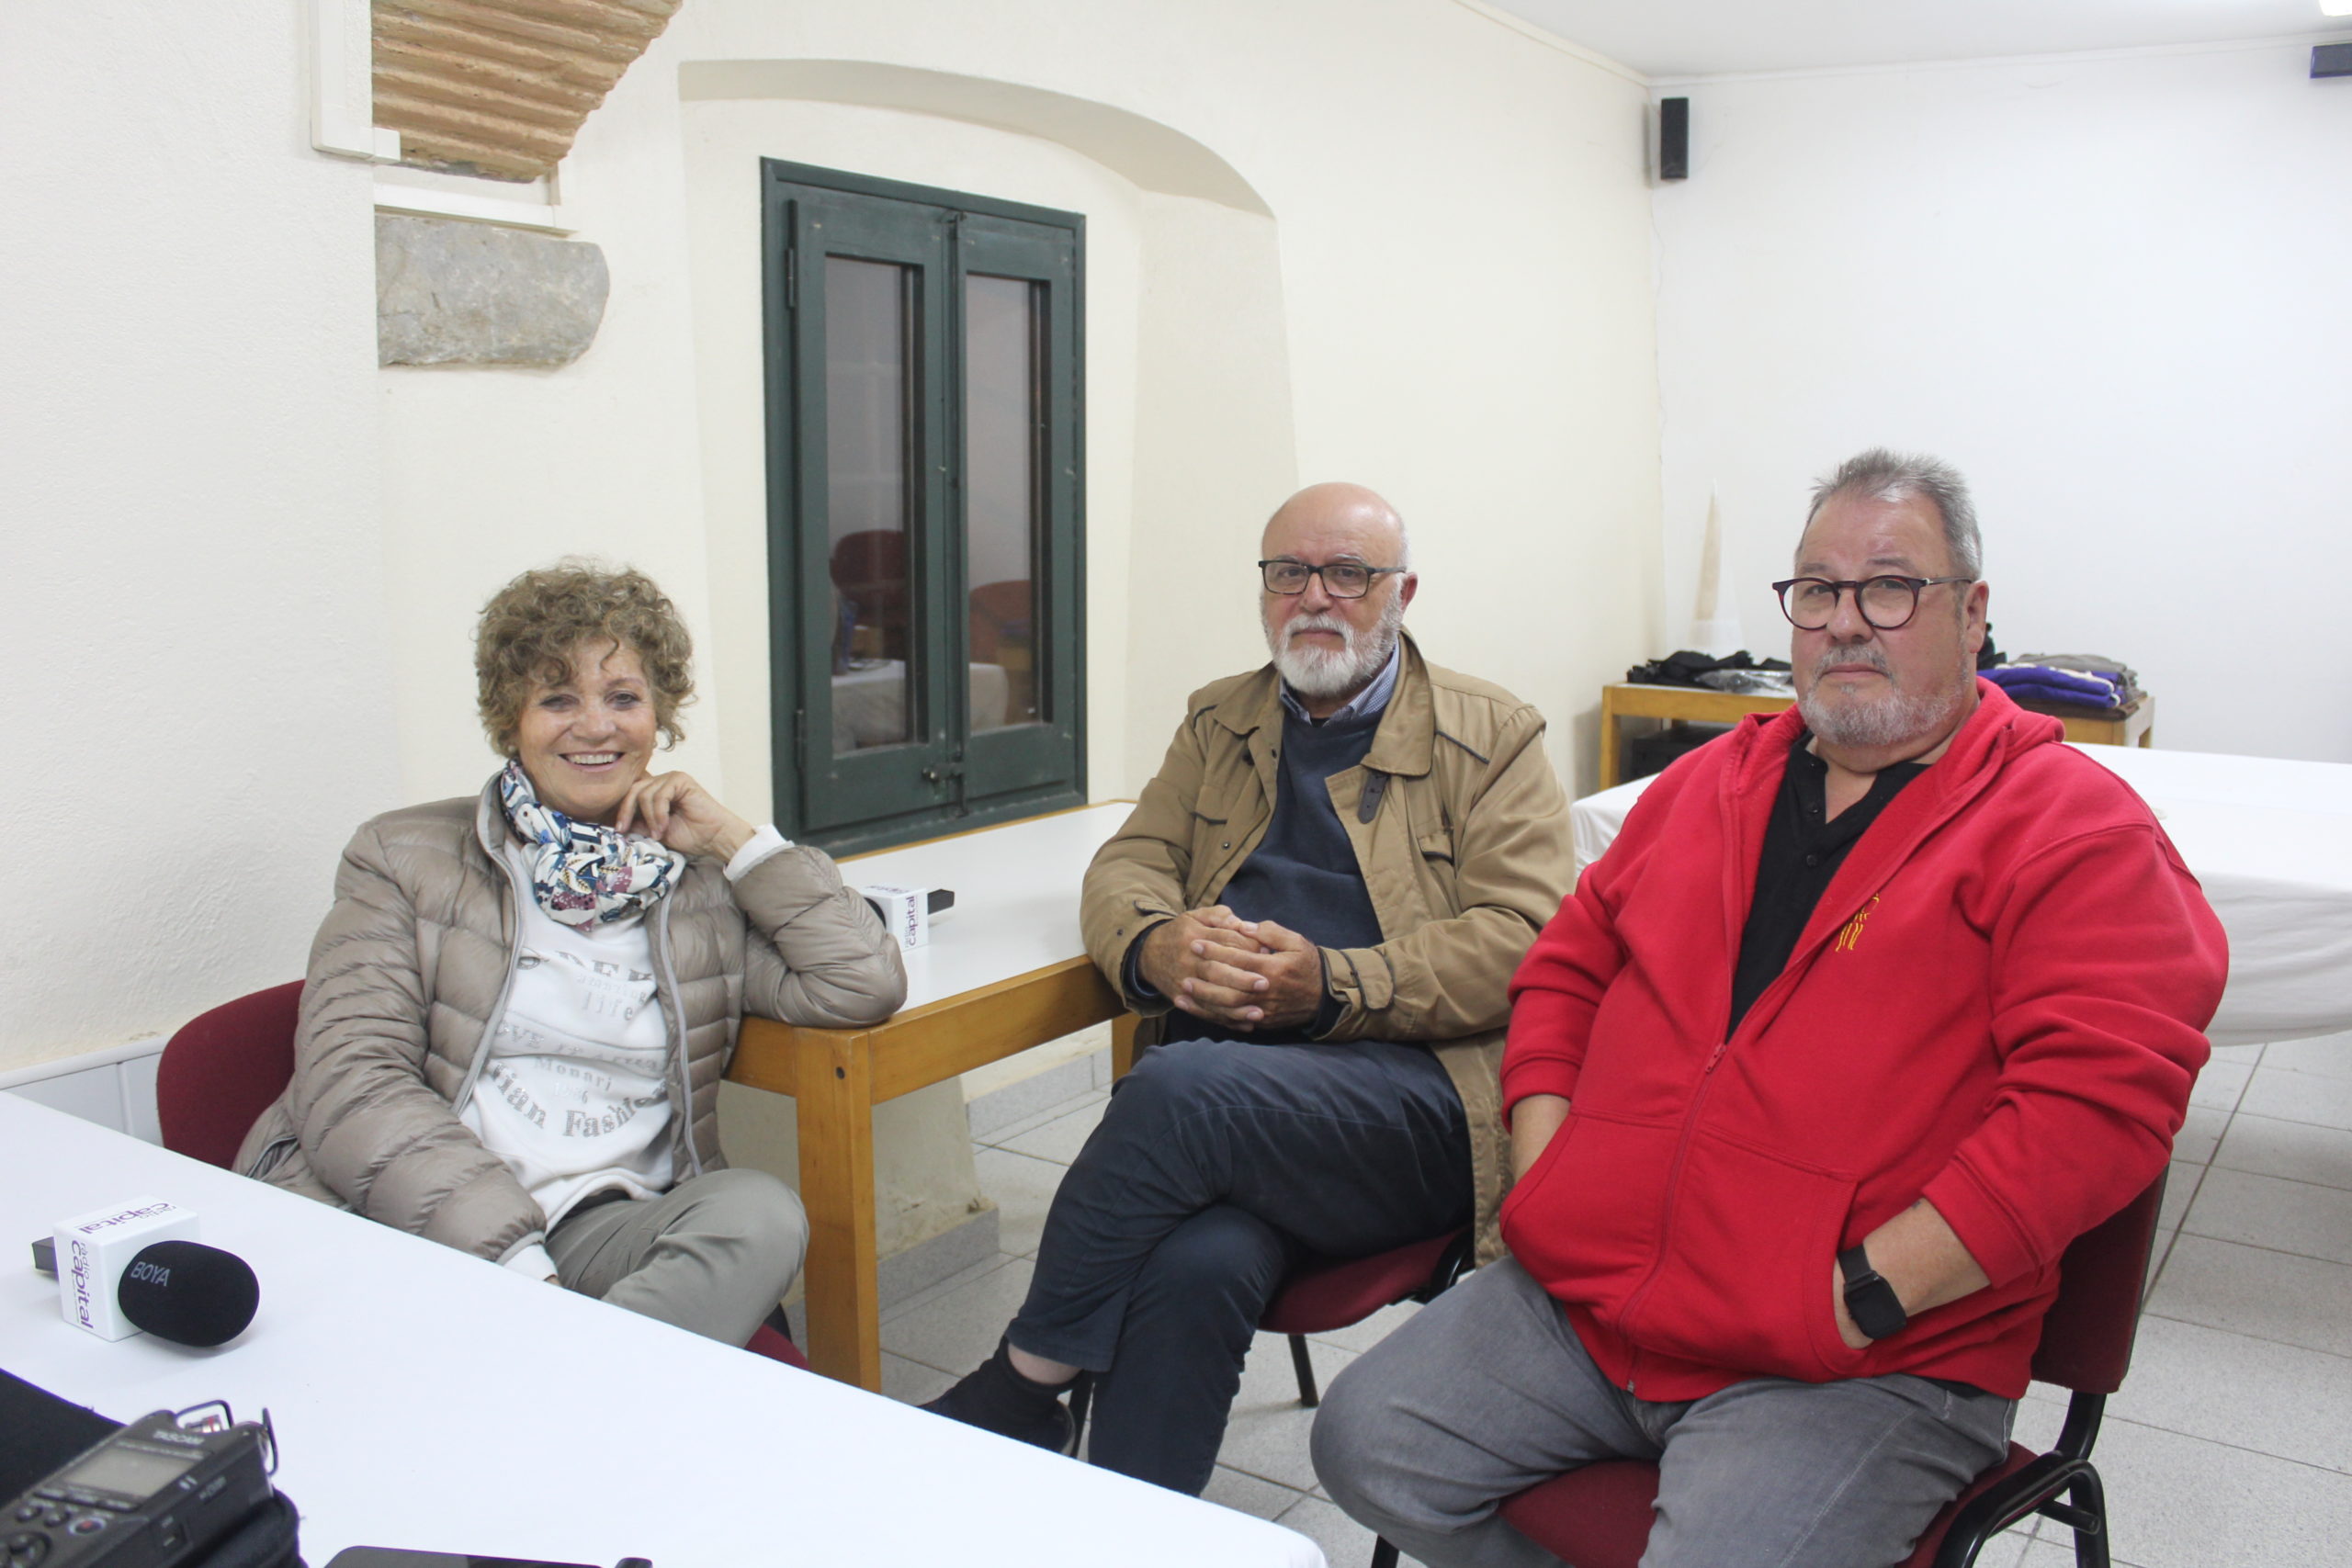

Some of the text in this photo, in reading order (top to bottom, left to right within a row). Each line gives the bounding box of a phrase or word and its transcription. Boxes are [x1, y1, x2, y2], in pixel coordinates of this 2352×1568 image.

[905, 896, 919, 946] capital
[78, 1202, 170, 1235] capital
[71, 1239, 95, 1329] capital
[130, 1261, 171, 1287] BOYA
